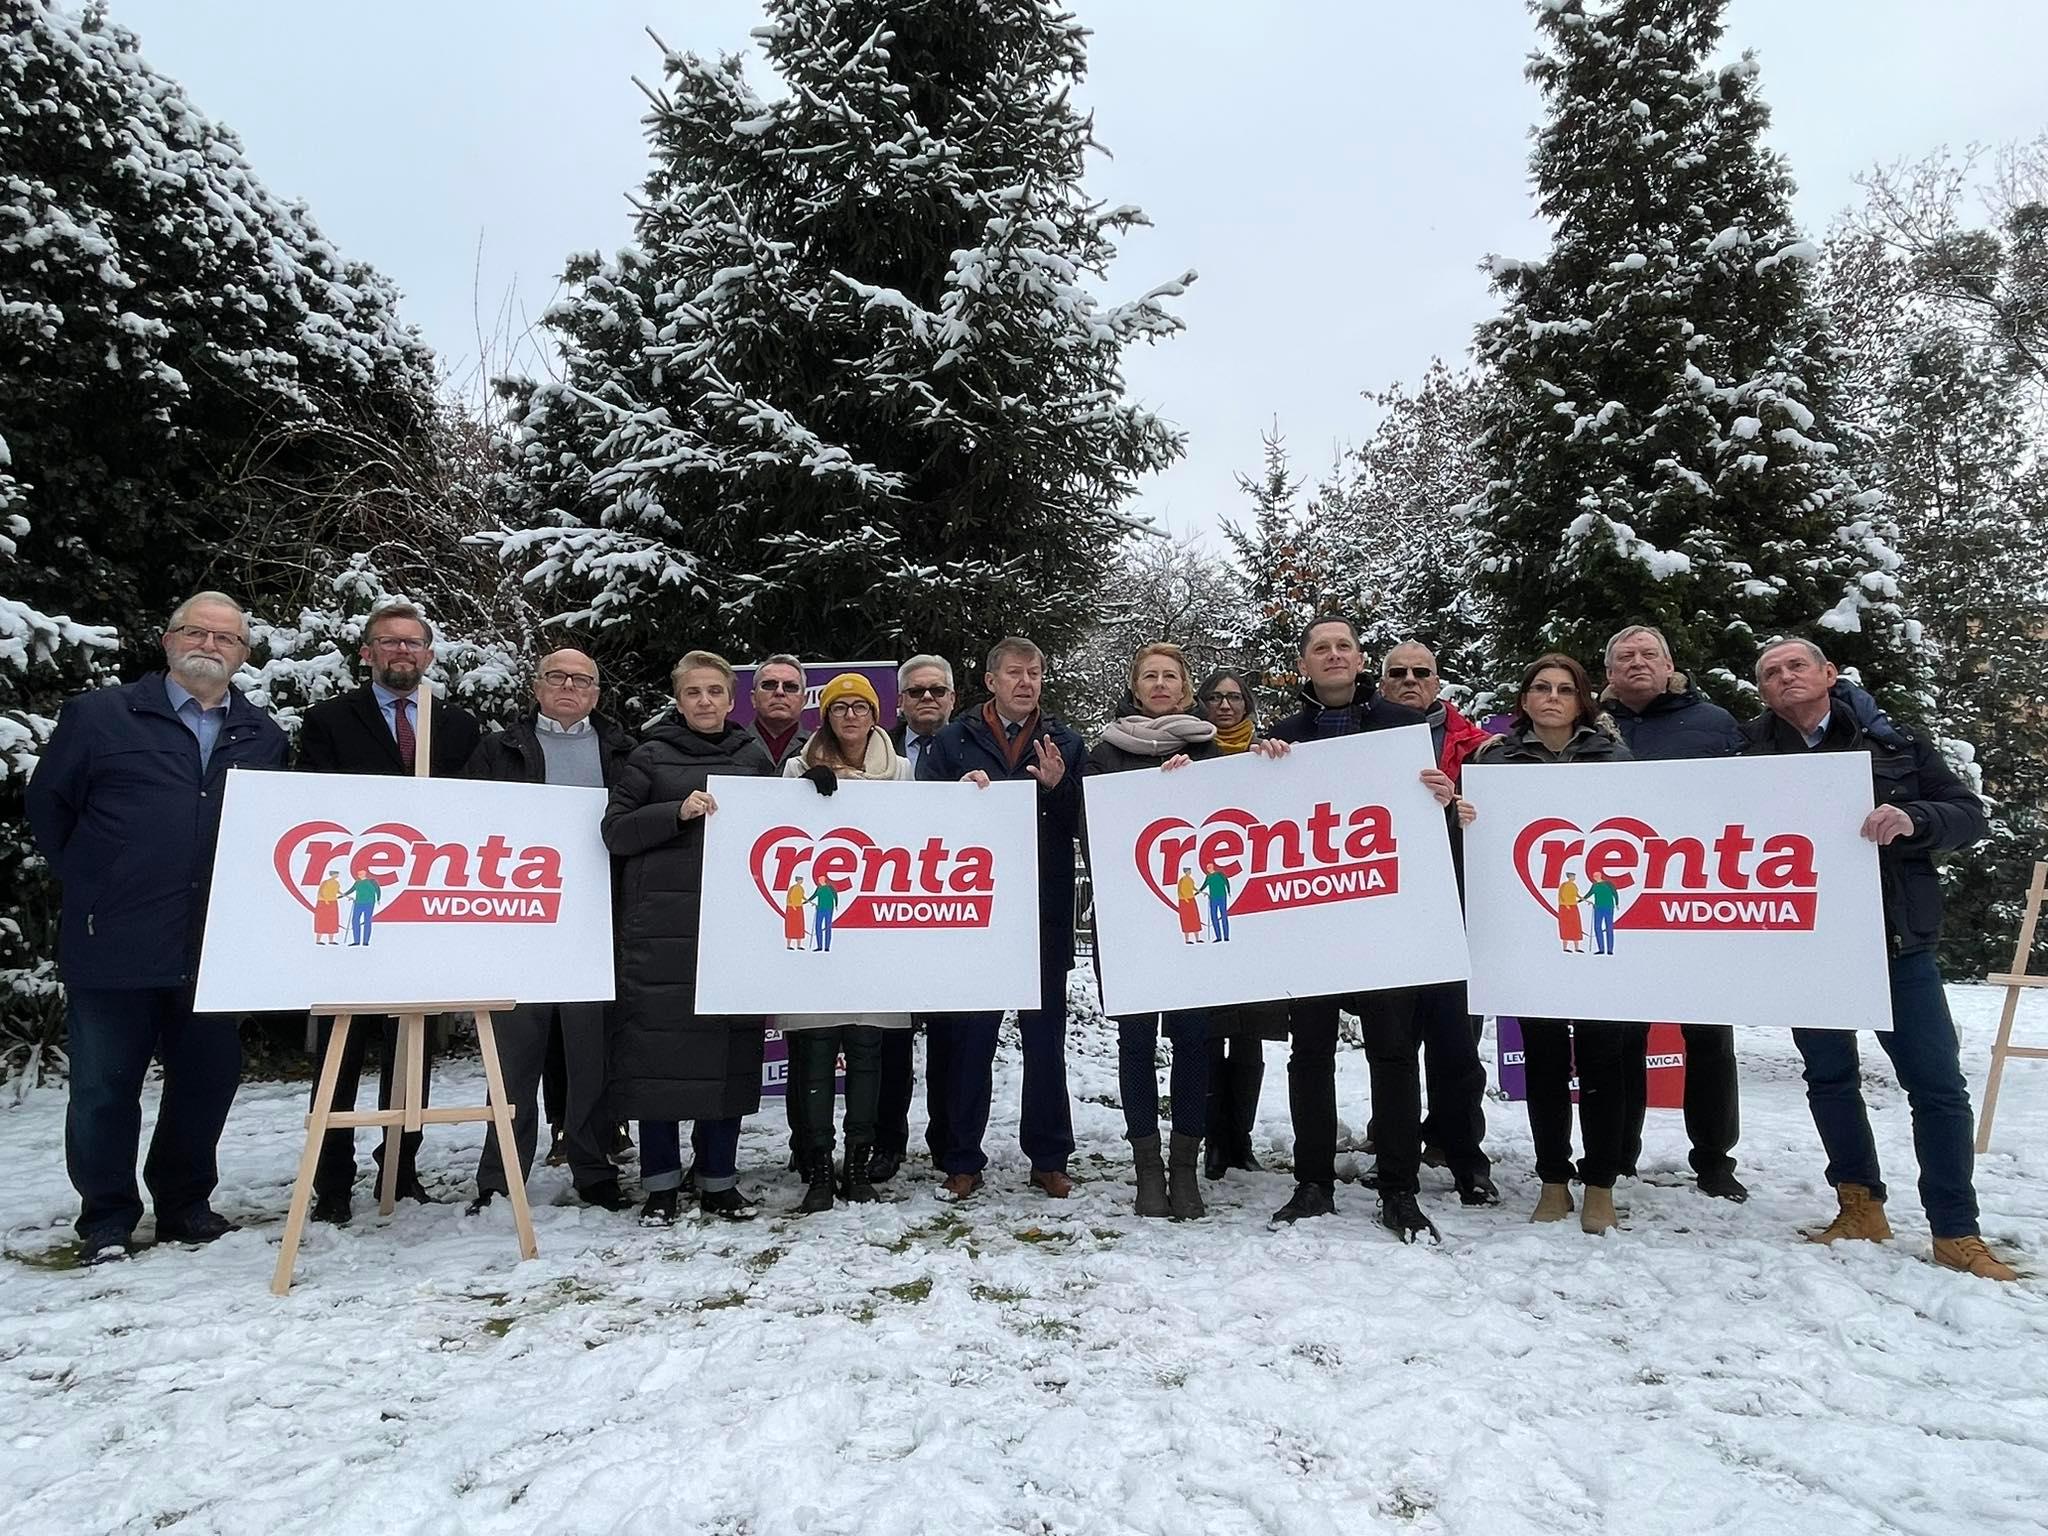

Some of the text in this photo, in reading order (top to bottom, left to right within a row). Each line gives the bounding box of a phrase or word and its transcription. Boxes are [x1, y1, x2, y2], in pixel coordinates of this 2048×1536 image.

[1160, 802, 1397, 886] renta
[1542, 824, 1817, 890] renta
[302, 836, 562, 889] renta
[773, 838, 994, 893] renta
[1265, 868, 1386, 903] WDOWIA
[421, 896, 546, 917] WDOWIA
[871, 902, 979, 922] WDOWIA
[1660, 900, 1800, 923] WDOWIA
[1647, 1055, 1681, 1066] WICA
